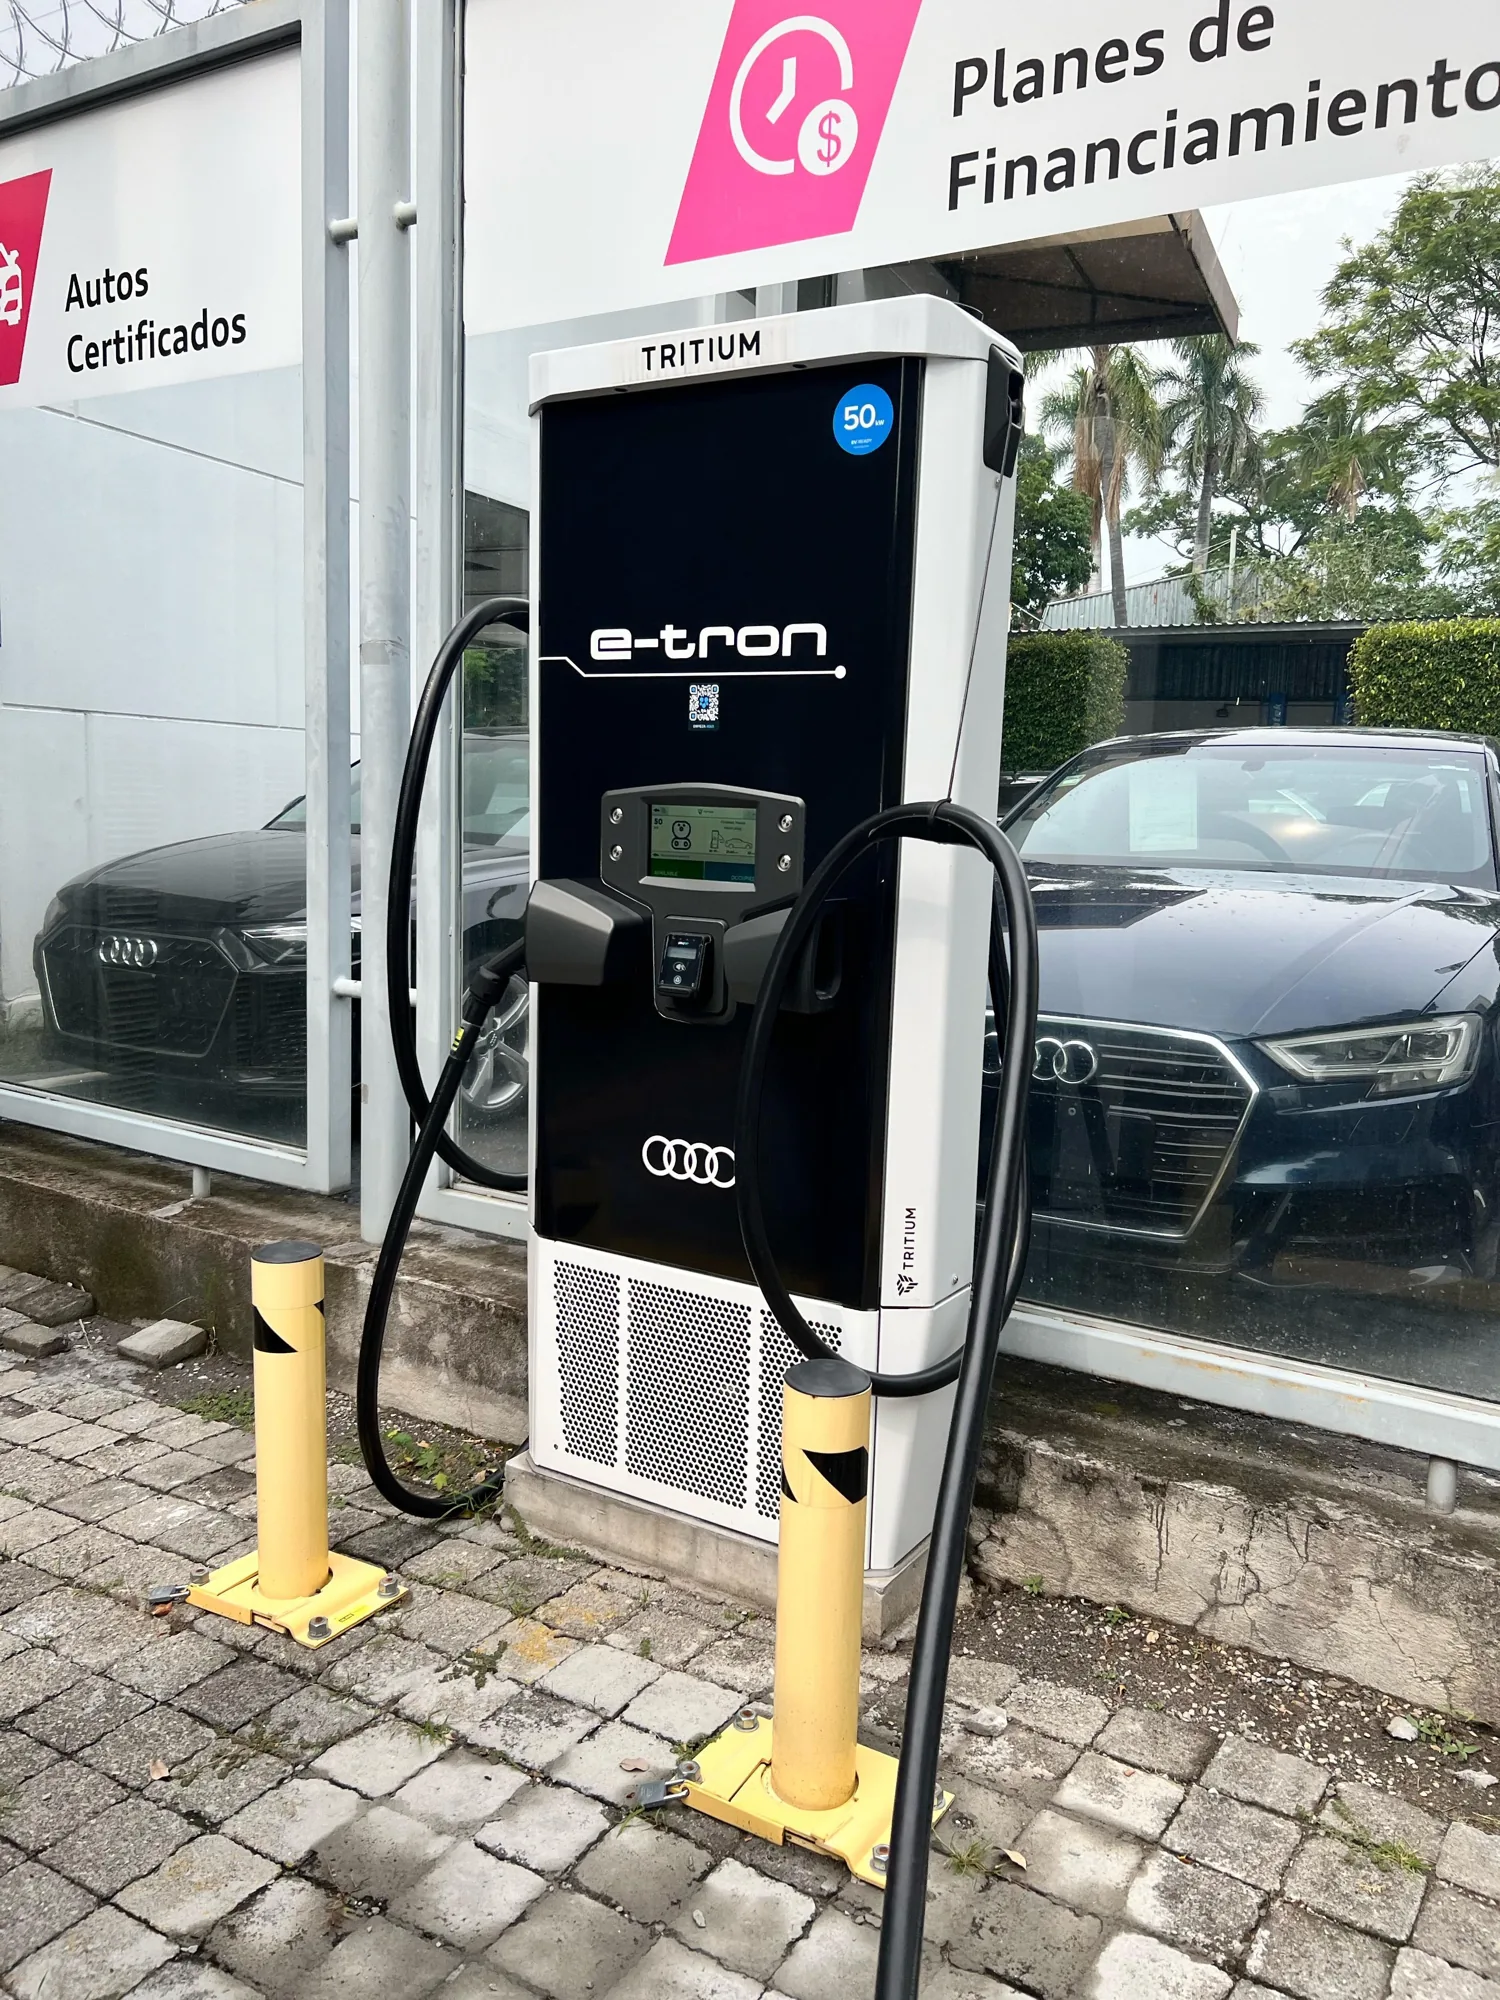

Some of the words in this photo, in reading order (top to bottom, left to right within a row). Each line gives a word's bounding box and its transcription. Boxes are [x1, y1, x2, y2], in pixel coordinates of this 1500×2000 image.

[953, 29, 1165, 118] Planes
[1189, 0, 1274, 63] de
[948, 58, 1500, 211] Financiamiento
[64, 267, 149, 313] Autos
[66, 308, 247, 373] Certificados
[641, 330, 761, 371] TRITIUM
[843, 403, 876, 431] 50
[590, 622, 827, 661] e-tron
[902, 1207, 917, 1271] TRITIUM
